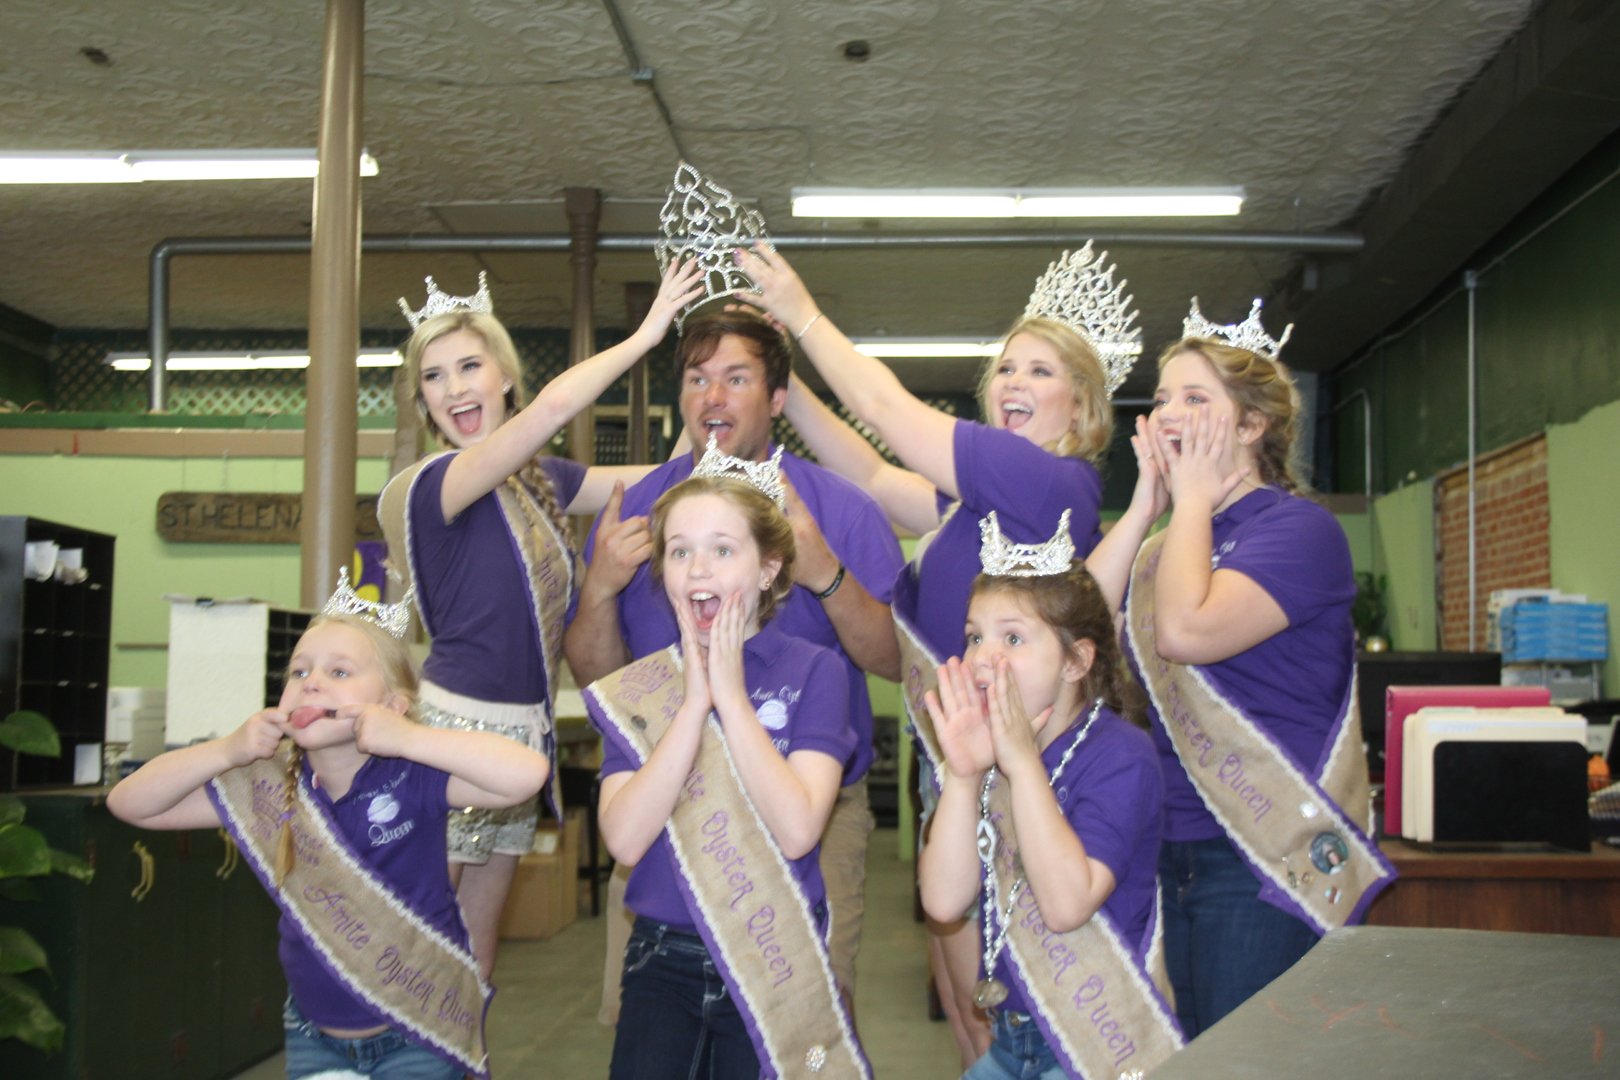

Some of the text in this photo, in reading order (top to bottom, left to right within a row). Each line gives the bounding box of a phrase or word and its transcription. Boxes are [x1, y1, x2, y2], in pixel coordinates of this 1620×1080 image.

[1216, 753, 1273, 824] Queen
[368, 823, 416, 847] Queen
[304, 886, 371, 951] Amite
[438, 987, 475, 1029] Quee
[746, 905, 793, 989] Queen
[1072, 974, 1137, 1068] Queen
